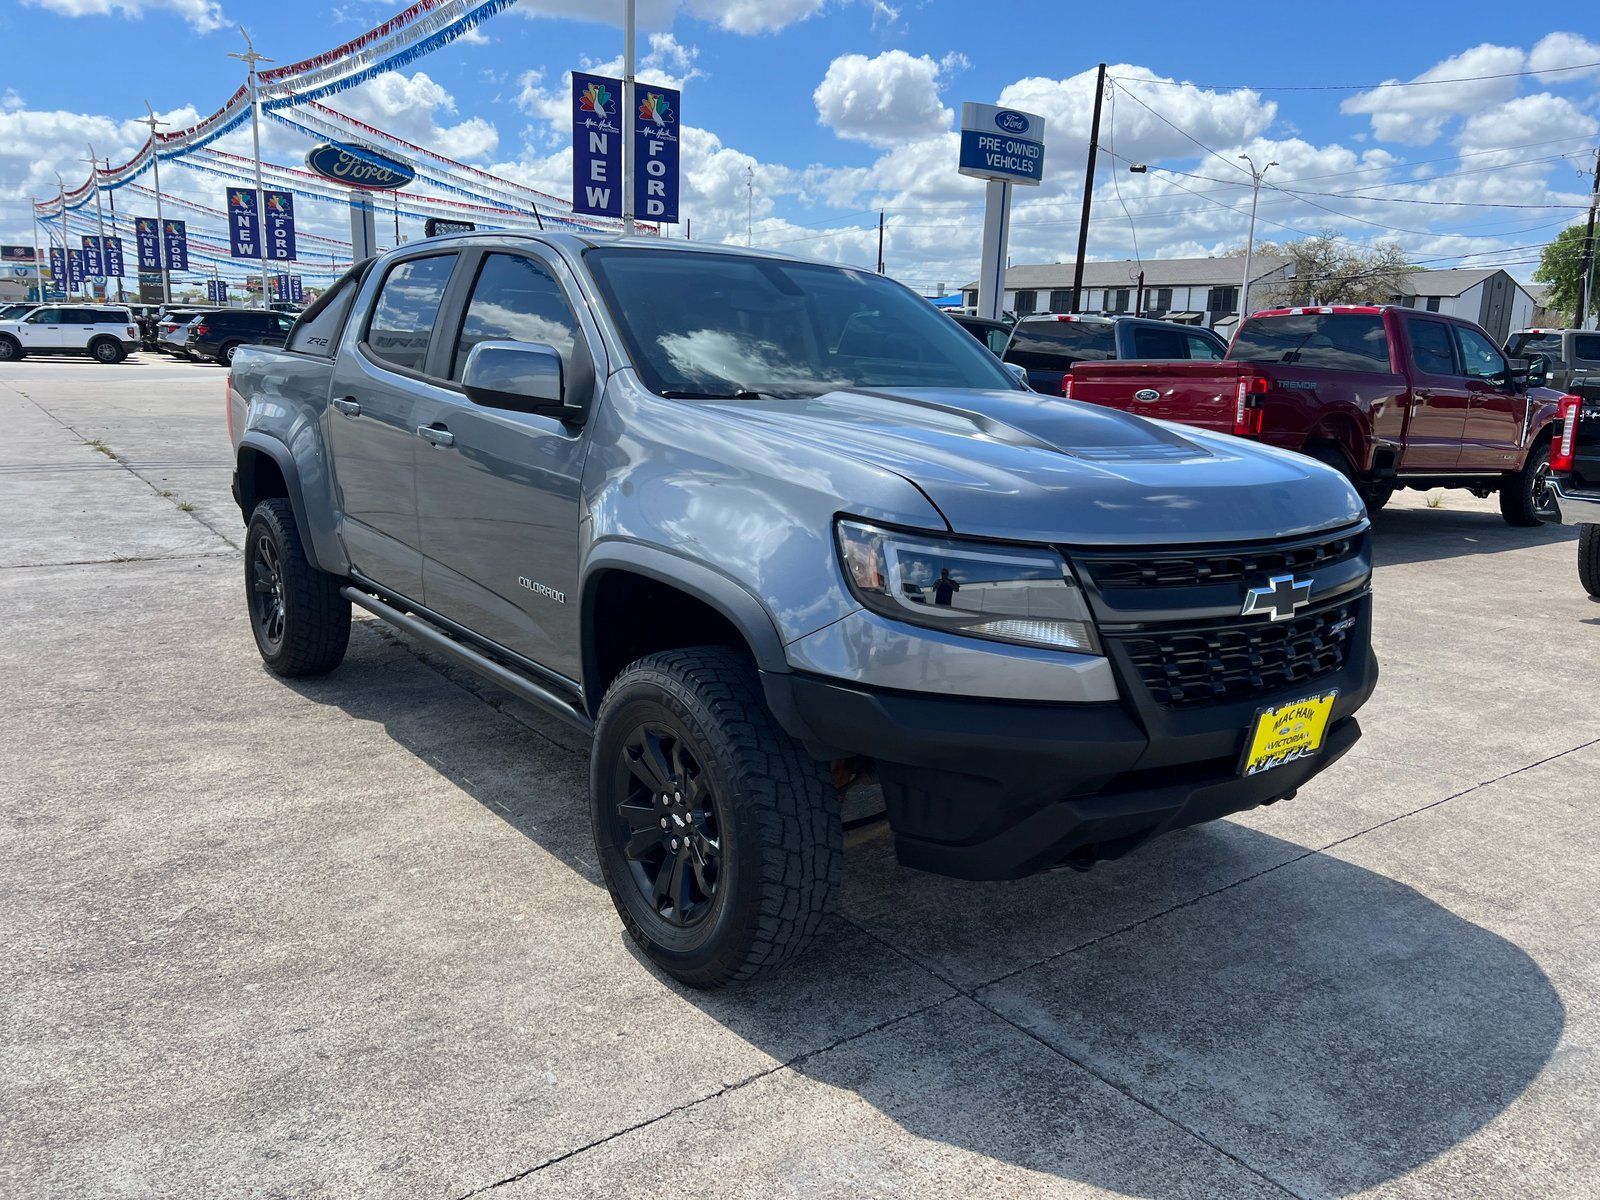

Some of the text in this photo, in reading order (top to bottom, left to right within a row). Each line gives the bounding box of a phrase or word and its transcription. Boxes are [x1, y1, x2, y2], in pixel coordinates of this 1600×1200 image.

[1003, 114, 1023, 129] Ford
[979, 136, 1039, 159] PRE-OWNED
[333, 150, 396, 183] Ford
[586, 131, 610, 209] NEW
[986, 153, 1034, 173] VEHICLES
[646, 139, 666, 216] FORD
[237, 215, 254, 255] NEW
[274, 219, 288, 258] FORD
[88, 251, 99, 274] NEW
[110, 252, 119, 276] FORD
[143, 238, 156, 267] NEW
[170, 240, 181, 269] FORD
[54, 260, 63, 280] NEW
[72, 261, 80, 281] FORD
[307, 336, 329, 347] ZR2
[1276, 380, 1317, 390] TREMOR
[518, 575, 565, 604] COLORADO
